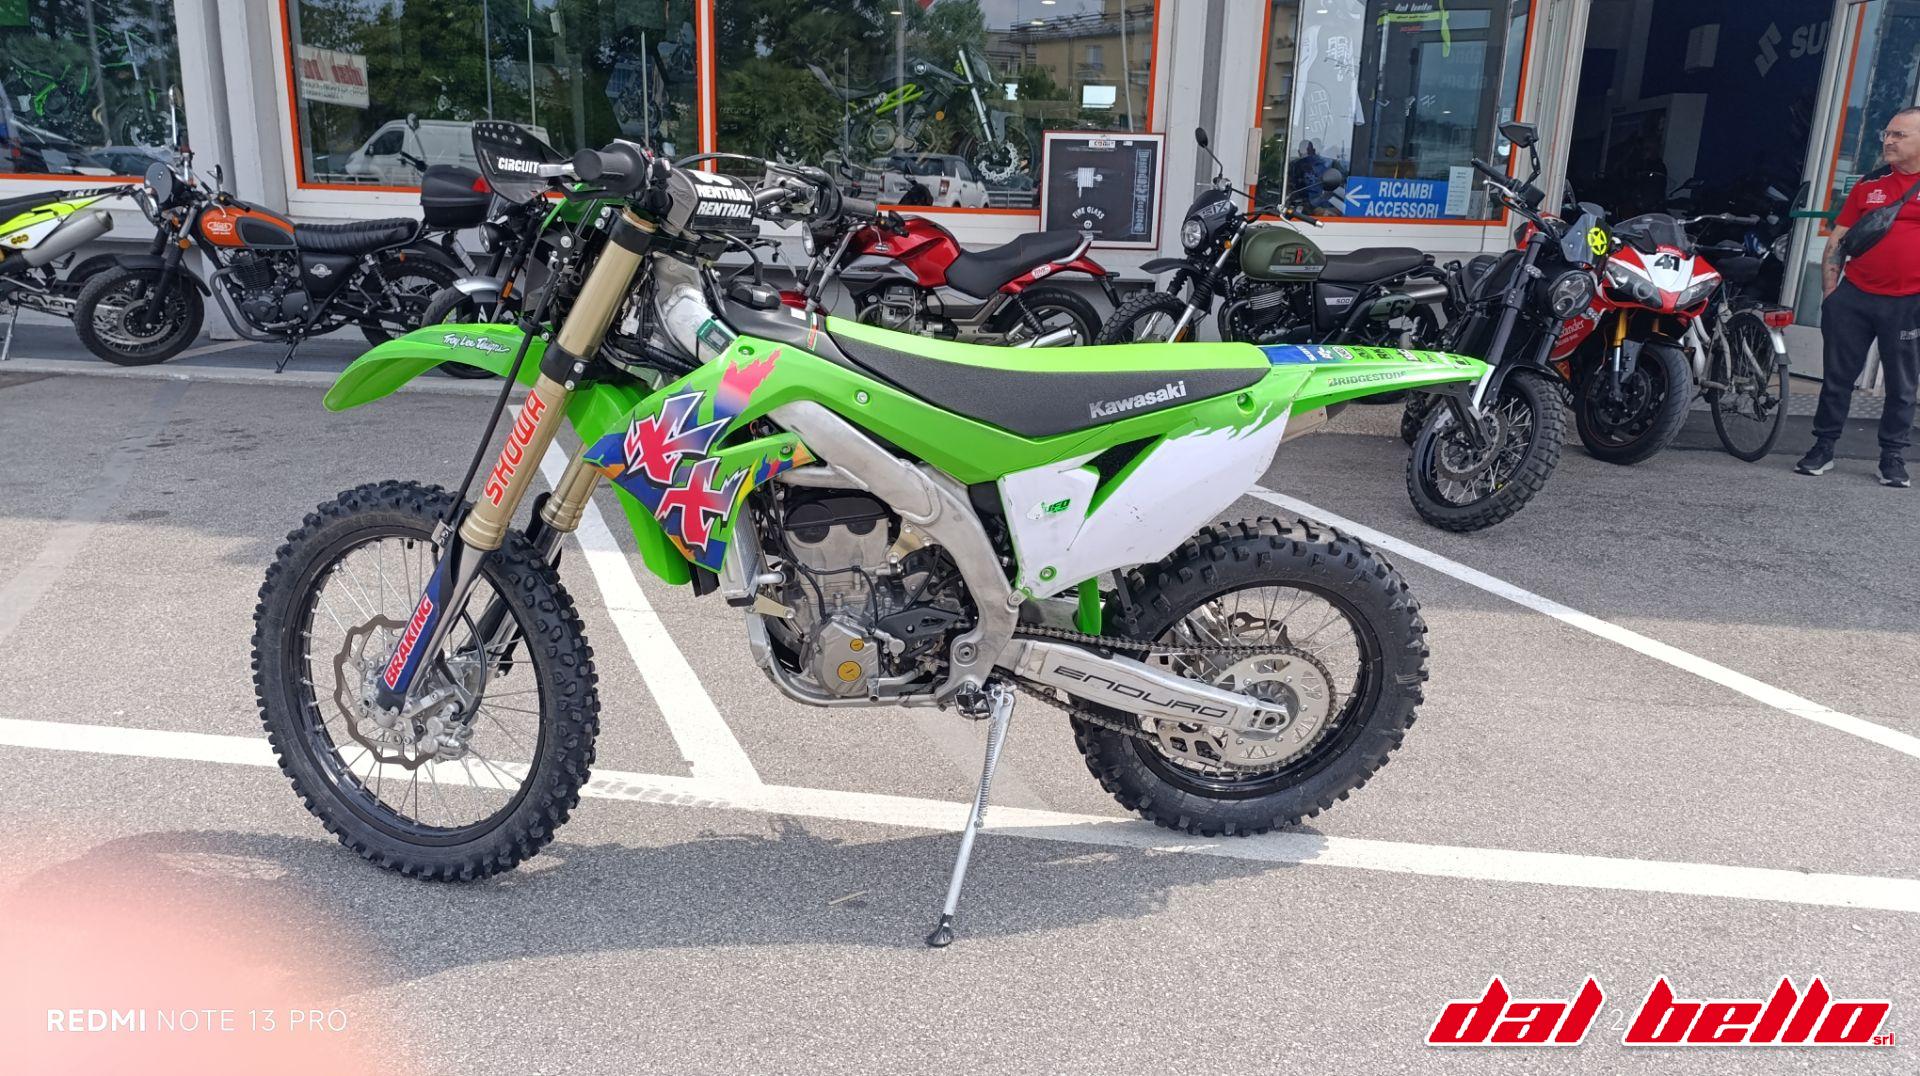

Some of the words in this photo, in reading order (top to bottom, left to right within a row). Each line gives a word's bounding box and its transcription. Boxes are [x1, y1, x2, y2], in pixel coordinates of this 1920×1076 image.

[497, 157, 540, 174] CIRCUIT
[695, 184, 753, 202] RENTHAL
[1378, 181, 1434, 199] RICAMBI
[696, 201, 752, 218] RENTHAL
[1072, 207, 1086, 219] FIRE
[1086, 206, 1105, 220] GLASS
[1365, 201, 1440, 218] ACCESSORI
[1654, 253, 1681, 272] 41
[1089, 380, 1187, 419] Kawasaki
[484, 388, 548, 507] SHOWA
[384, 592, 434, 690] BRAKING
[1053, 665, 1228, 719] ENDURO
